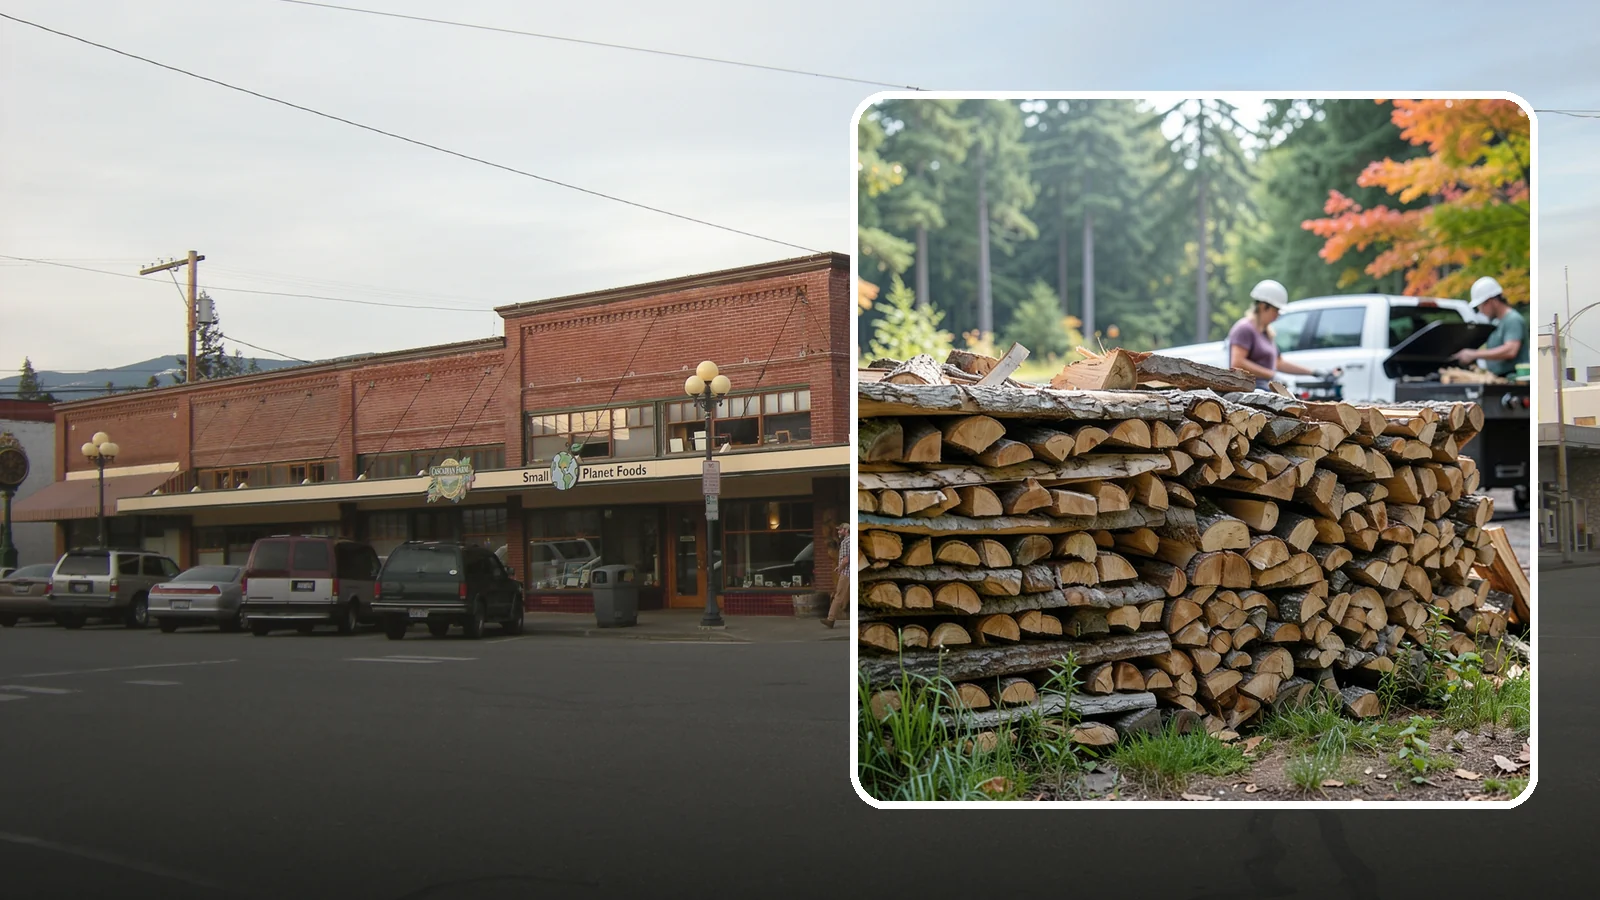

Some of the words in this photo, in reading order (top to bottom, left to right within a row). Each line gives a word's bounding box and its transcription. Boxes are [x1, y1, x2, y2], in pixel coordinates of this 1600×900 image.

[523, 471, 549, 483] Small
[583, 467, 614, 479] Planet
[617, 464, 647, 477] Foods
